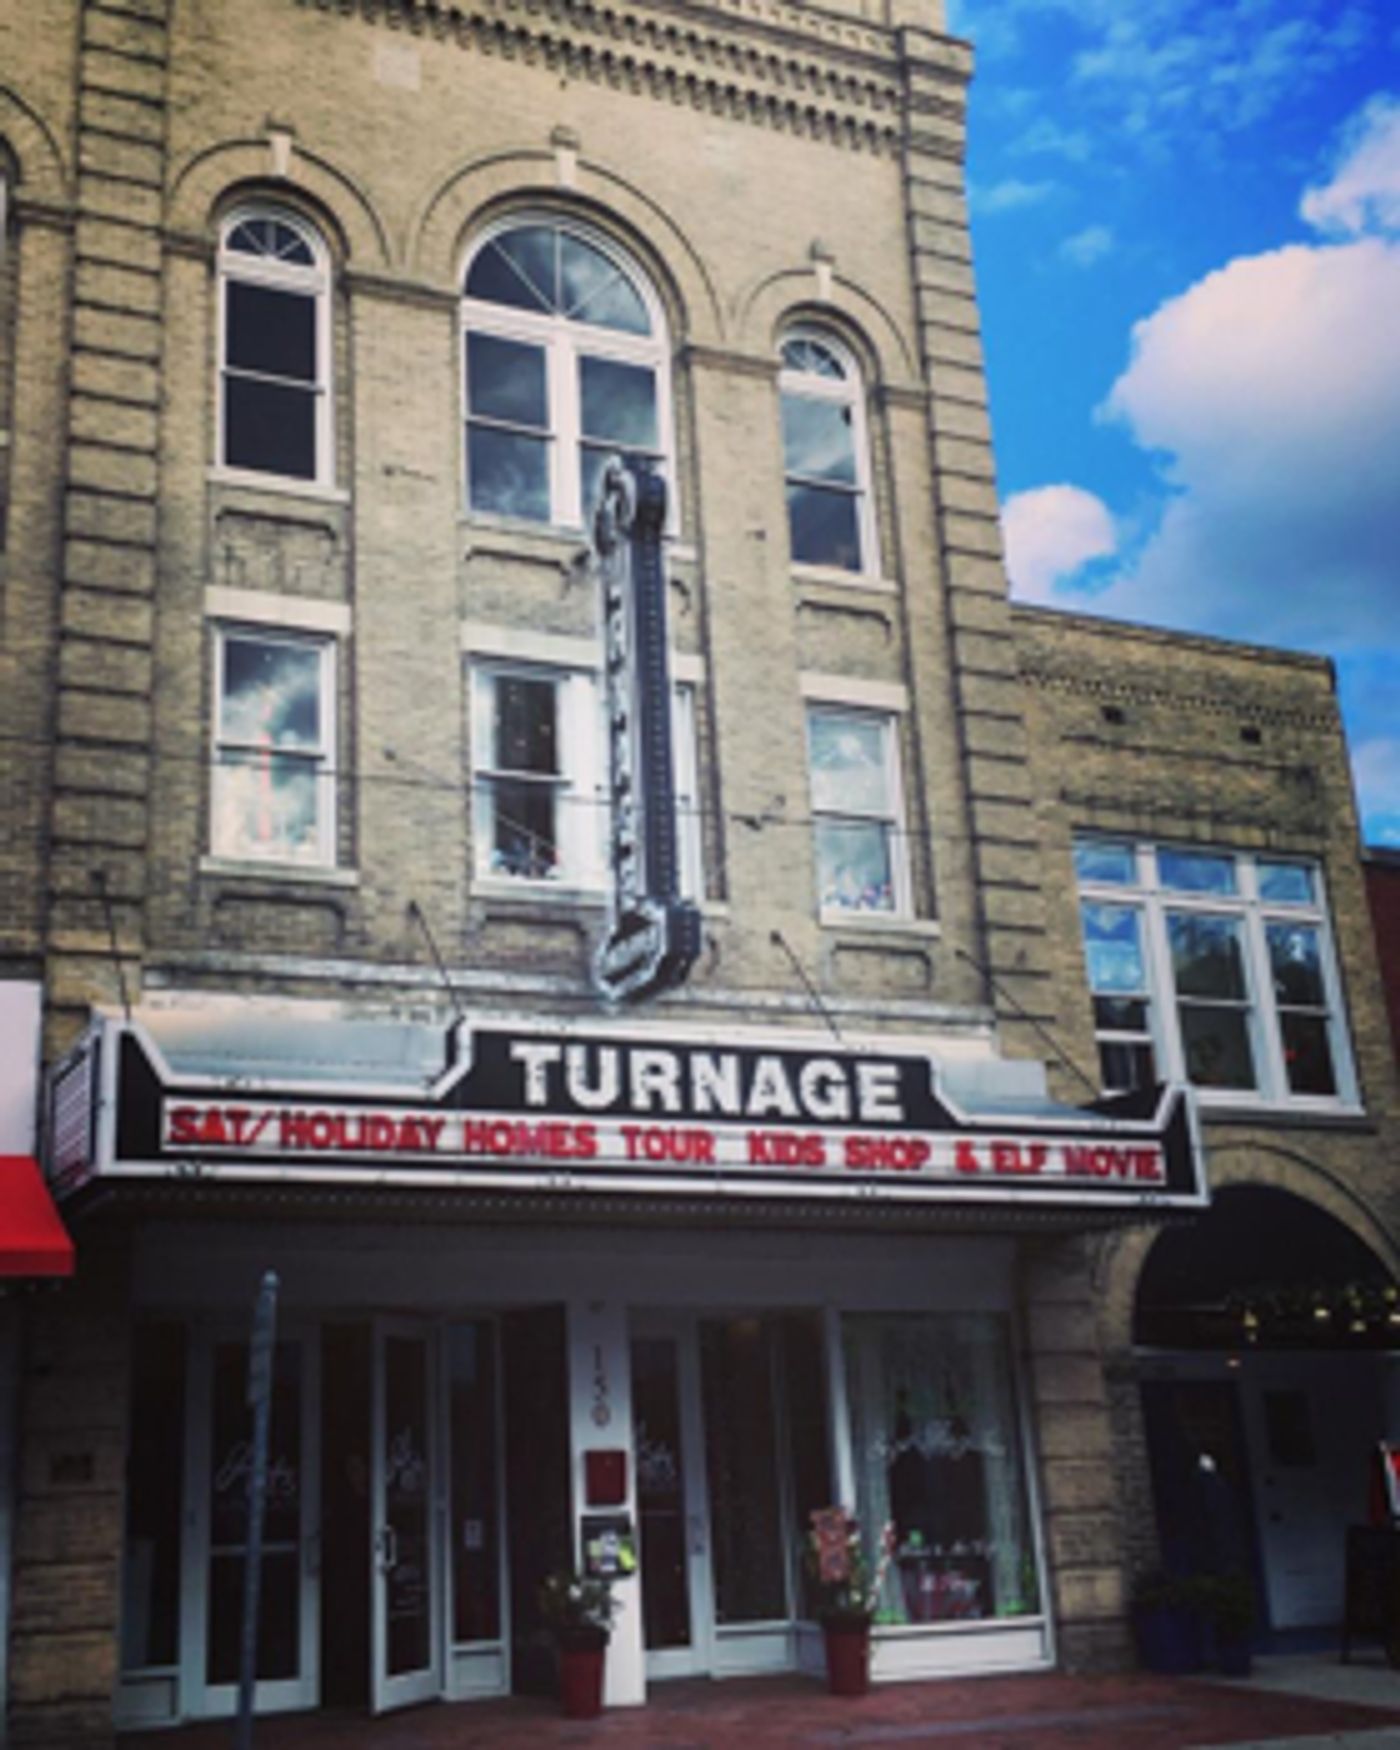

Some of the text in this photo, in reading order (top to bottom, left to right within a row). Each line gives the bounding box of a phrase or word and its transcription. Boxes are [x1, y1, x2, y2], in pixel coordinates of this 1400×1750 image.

[509, 1040, 904, 1123] TURNAGE
[279, 1109, 444, 1151] HOLIDAY
[463, 1117, 599, 1158] HOMES
[620, 1123, 716, 1163] TOUR
[747, 1129, 828, 1167] KIDS
[842, 1134, 932, 1171] SHOP
[953, 1139, 980, 1174] &
[990, 1140, 1048, 1175] ELF
[1062, 1144, 1162, 1181] MOVIE
